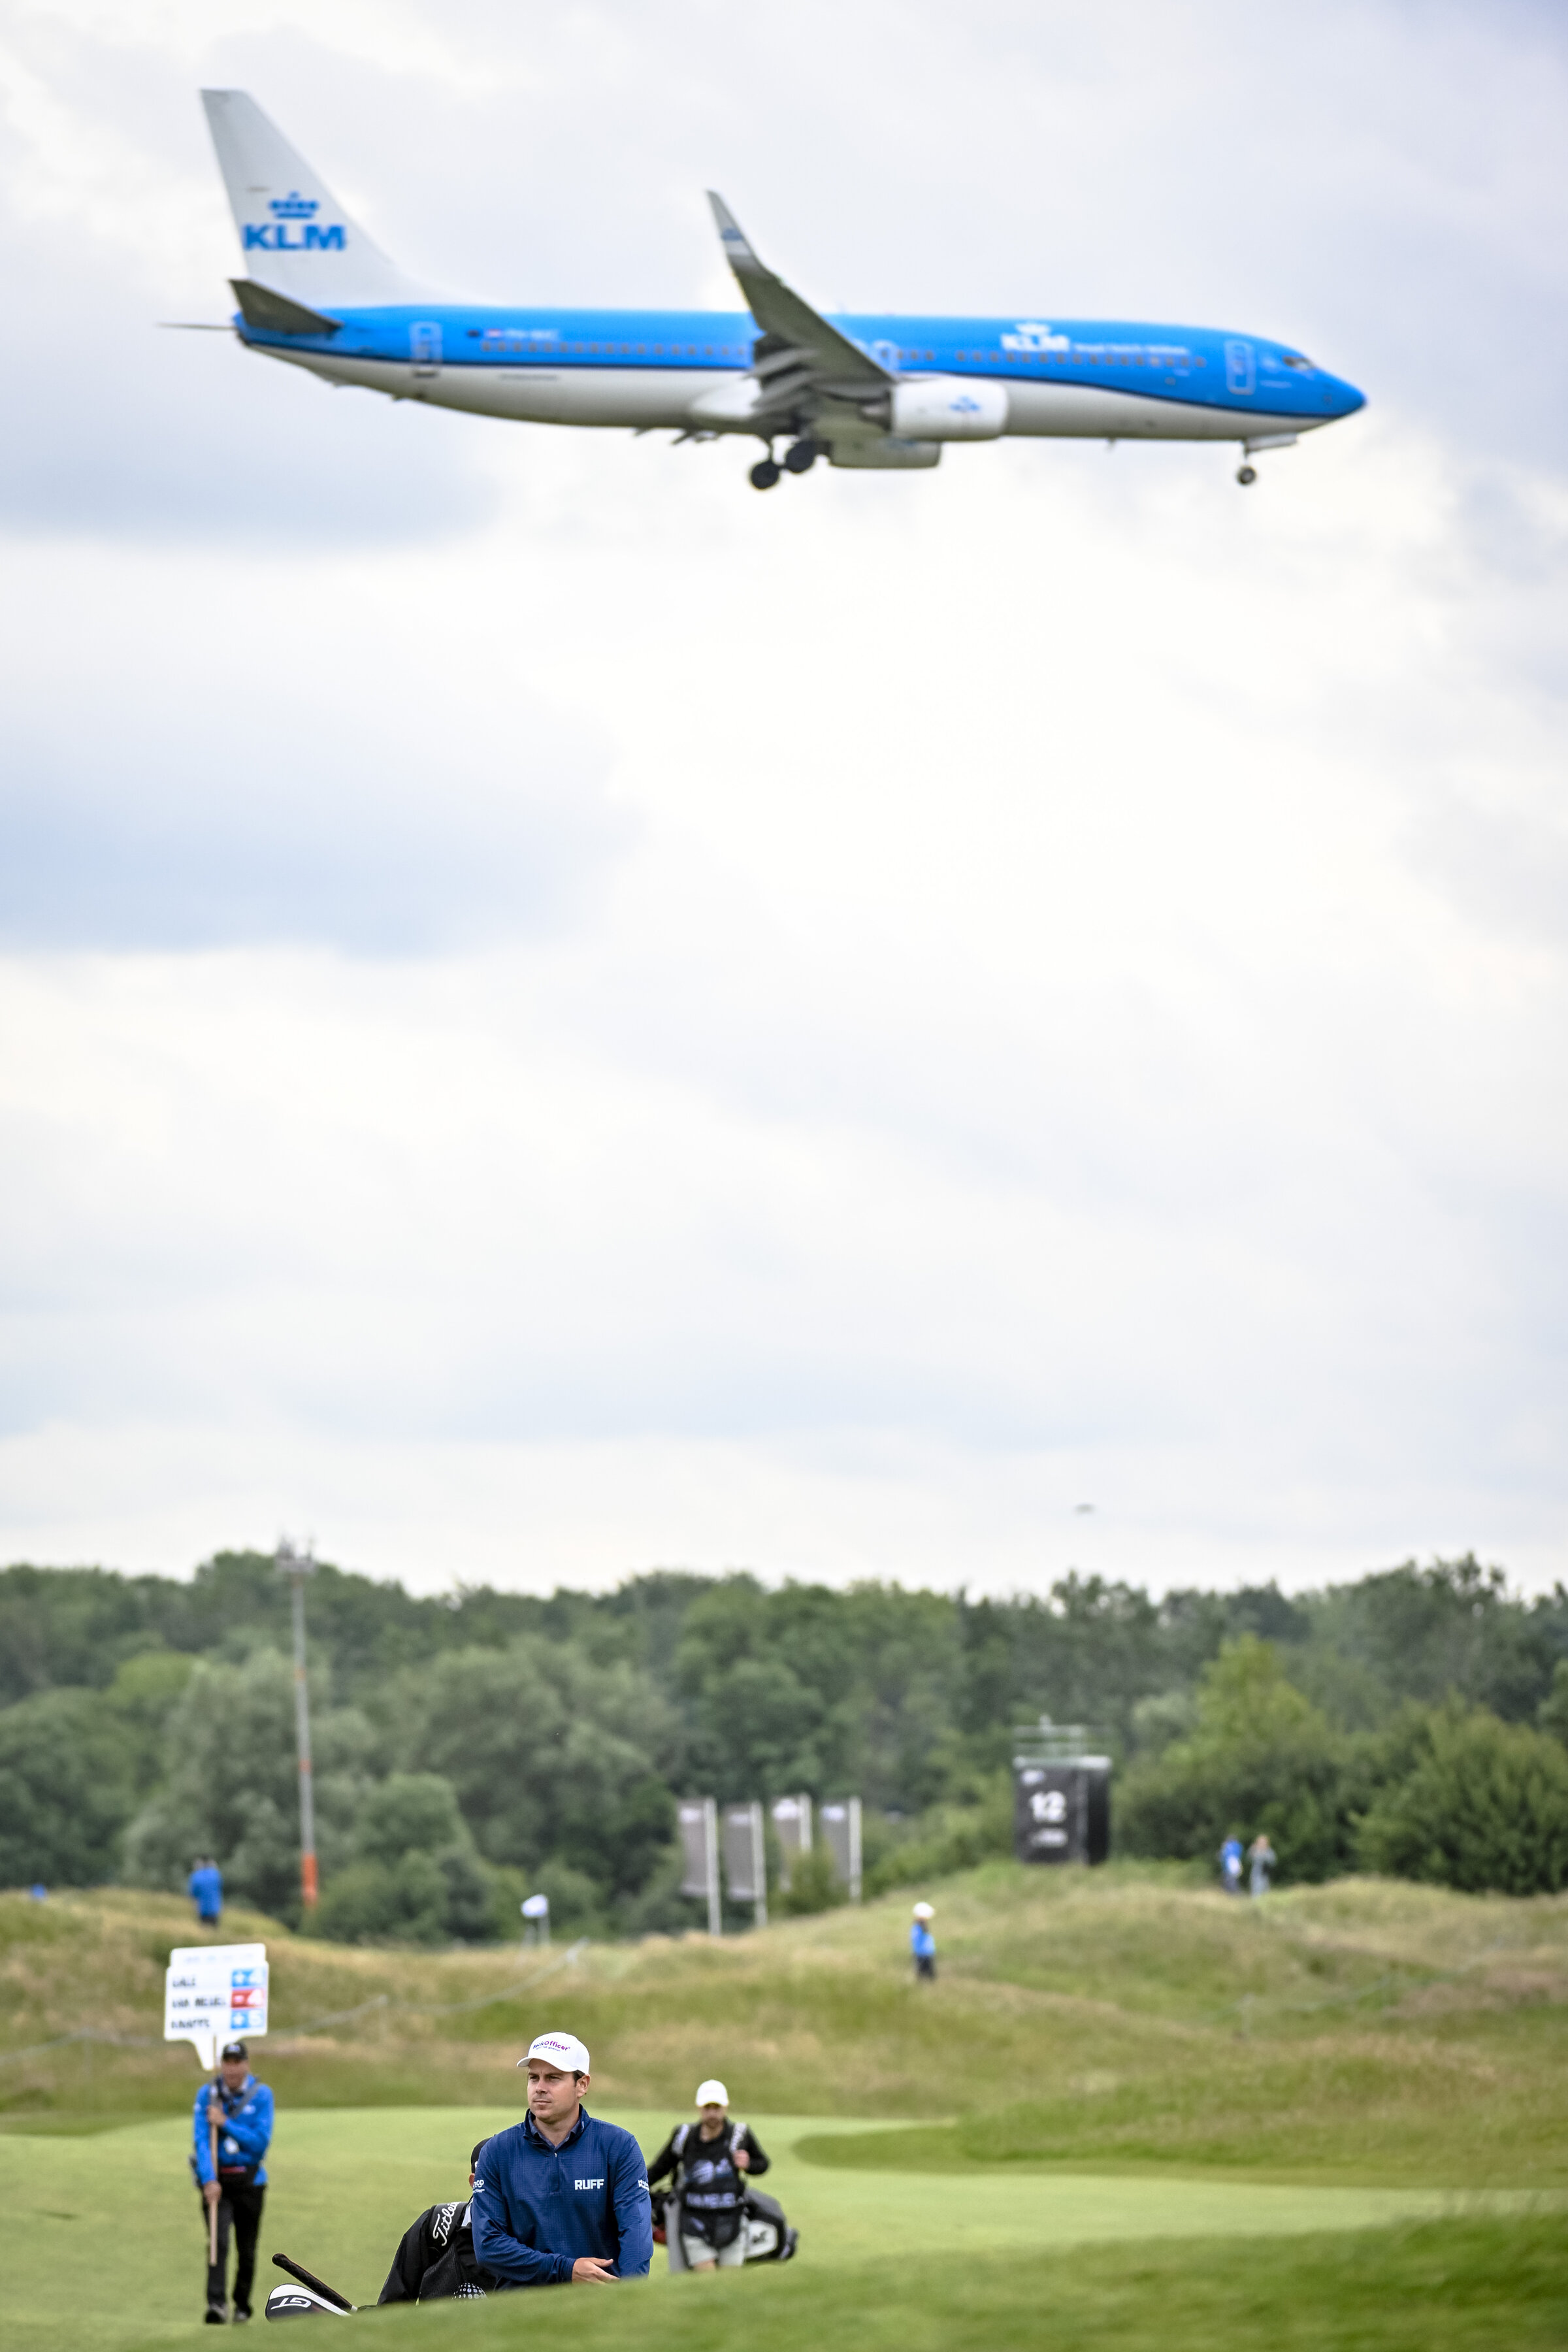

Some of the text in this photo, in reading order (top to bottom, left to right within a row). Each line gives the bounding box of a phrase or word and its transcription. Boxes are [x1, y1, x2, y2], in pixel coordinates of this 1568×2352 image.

[243, 223, 346, 252] KLM
[574, 2178, 604, 2190] RUFF
[270, 2296, 312, 2310] GT
